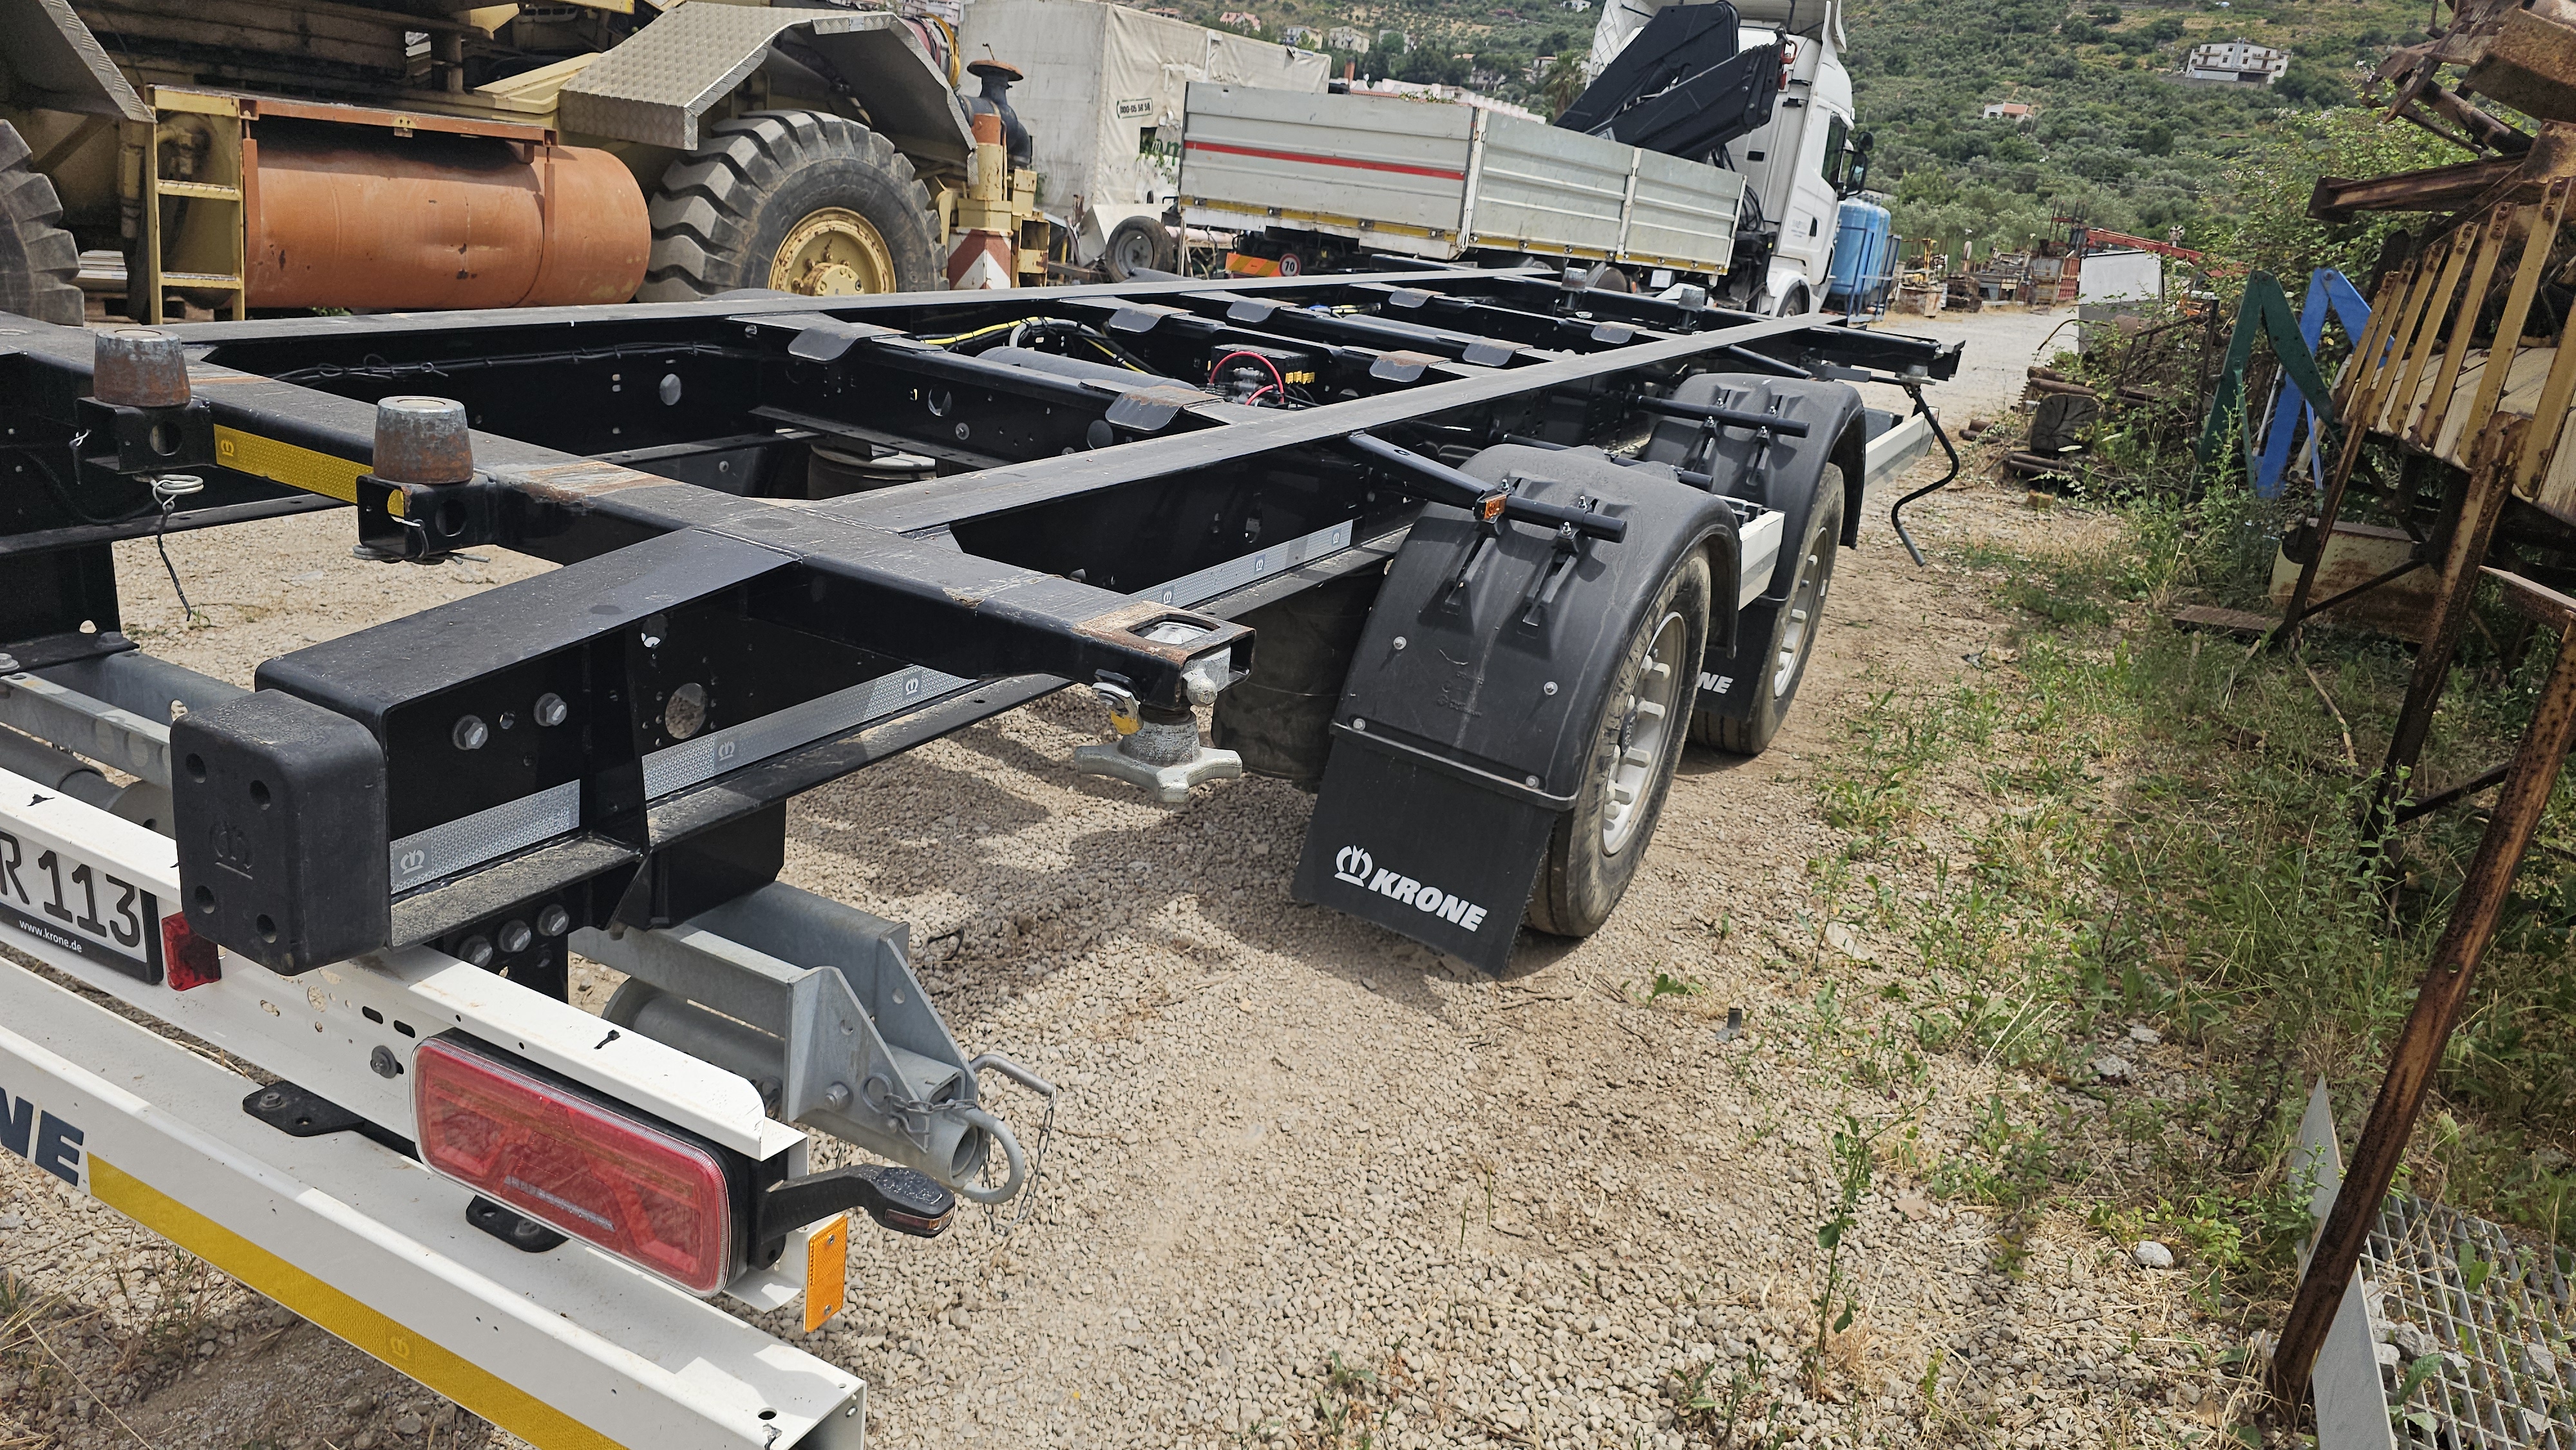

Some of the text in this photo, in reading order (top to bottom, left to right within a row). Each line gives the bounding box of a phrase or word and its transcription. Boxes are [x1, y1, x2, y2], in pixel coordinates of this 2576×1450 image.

[1285, 261, 1295, 272] 70
[37, 849, 141, 948] 113
[1367, 867, 1488, 932] KRONE
[19, 919, 83, 953] www.krone.de
